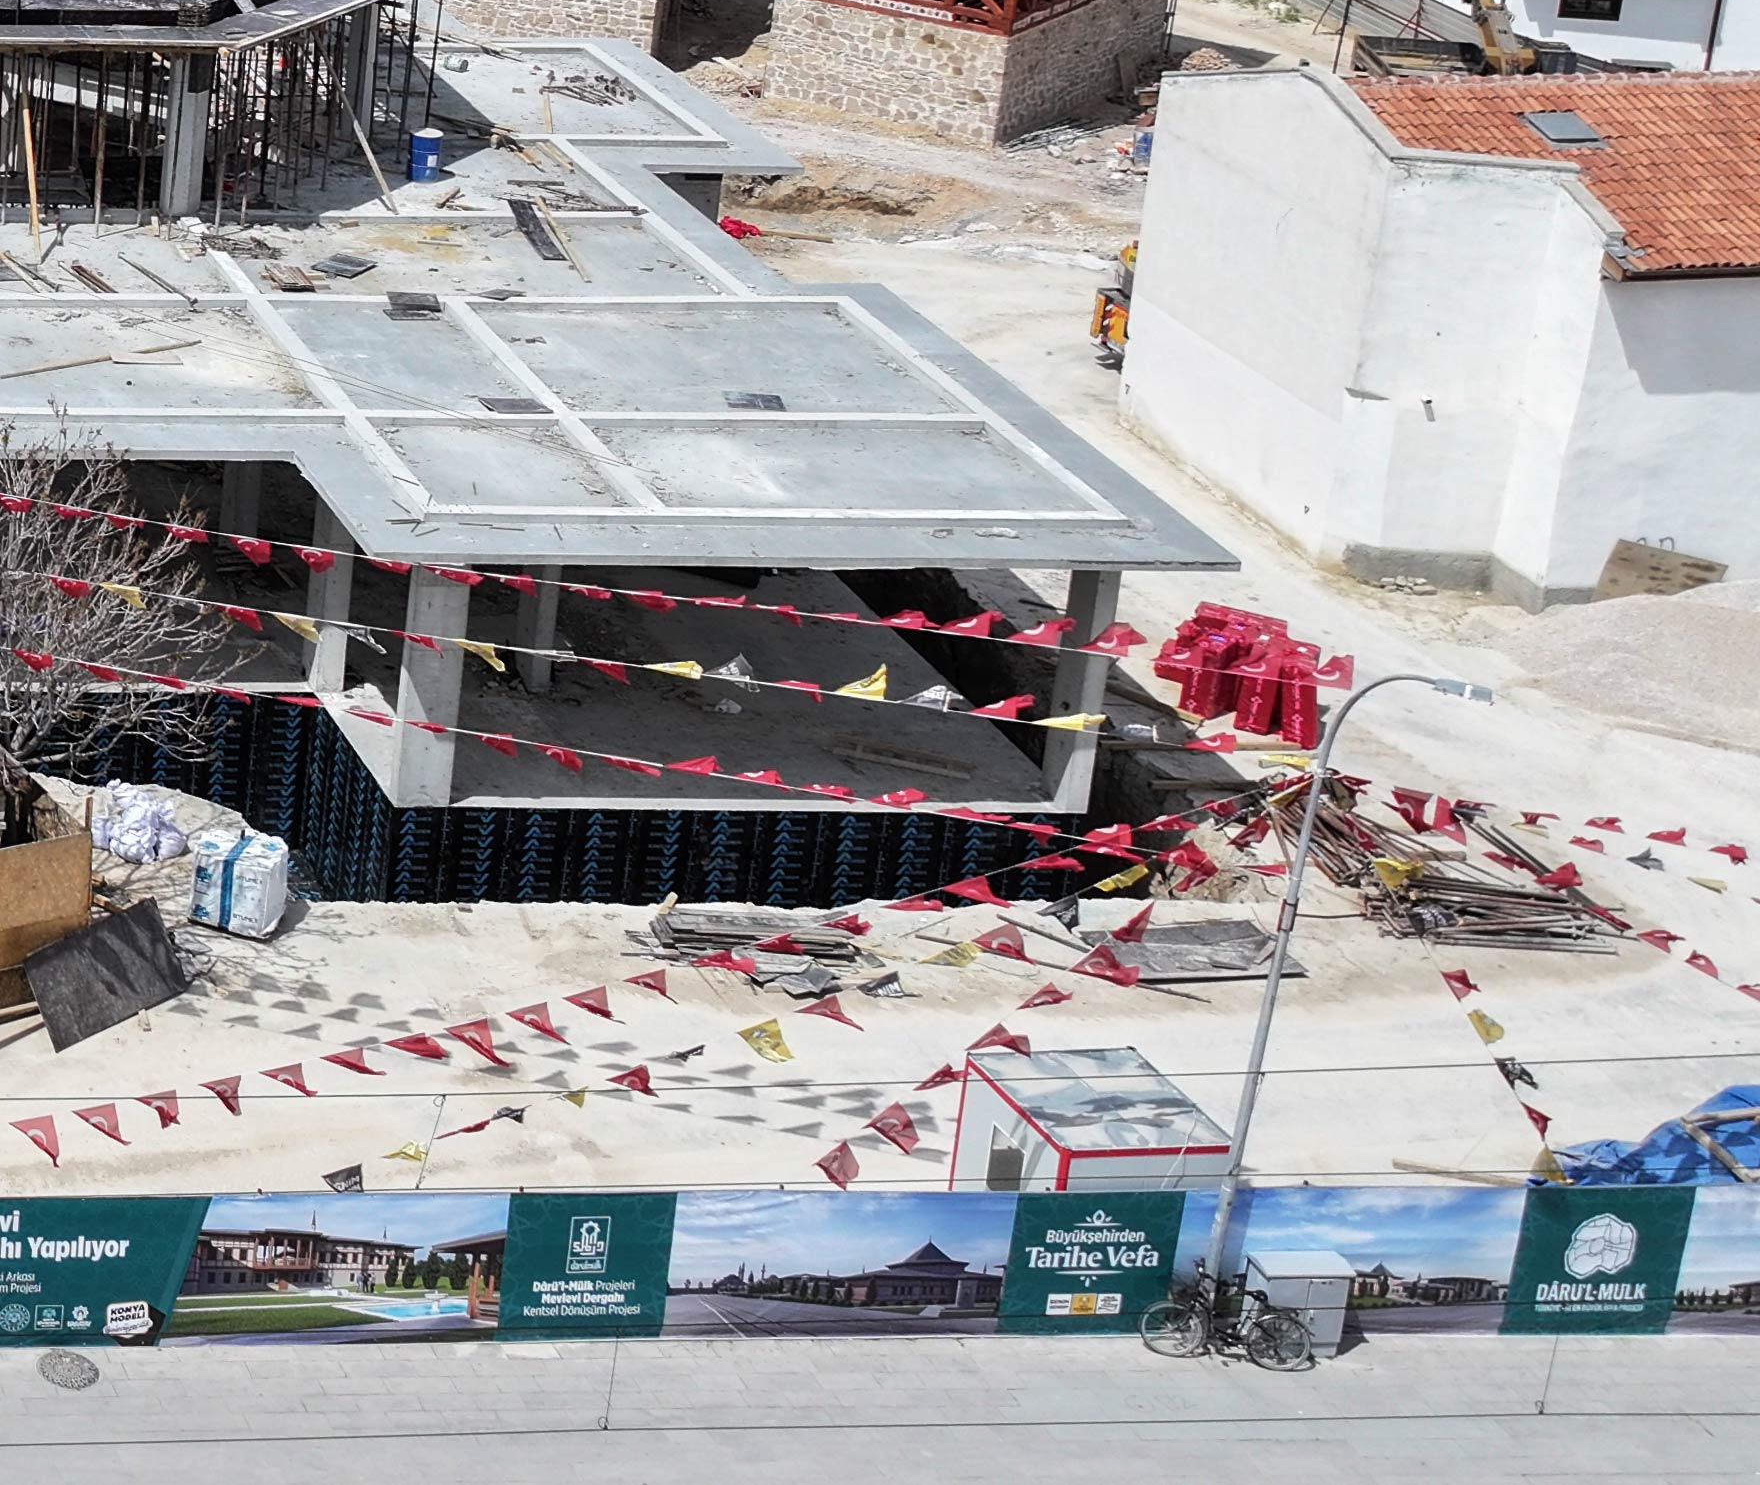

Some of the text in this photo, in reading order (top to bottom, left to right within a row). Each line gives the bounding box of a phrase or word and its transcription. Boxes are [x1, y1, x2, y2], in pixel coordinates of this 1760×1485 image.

[1045, 1229, 1145, 1245] Büyükşehirden
[27, 1235, 130, 1262] Yapılıyor
[1025, 1244, 1160, 1268] Tarihe Vefa
[6, 1272, 35, 1282] Arkası
[10, 1282, 42, 1294] Projesi
[595, 1279, 636, 1292] Projeleri
[541, 1292, 625, 1305] Mevlevi Dergahı
[110, 1304, 146, 1316] KONYA
[523, 1304, 641, 1317] Kentsel Dönüşüm Projesi
